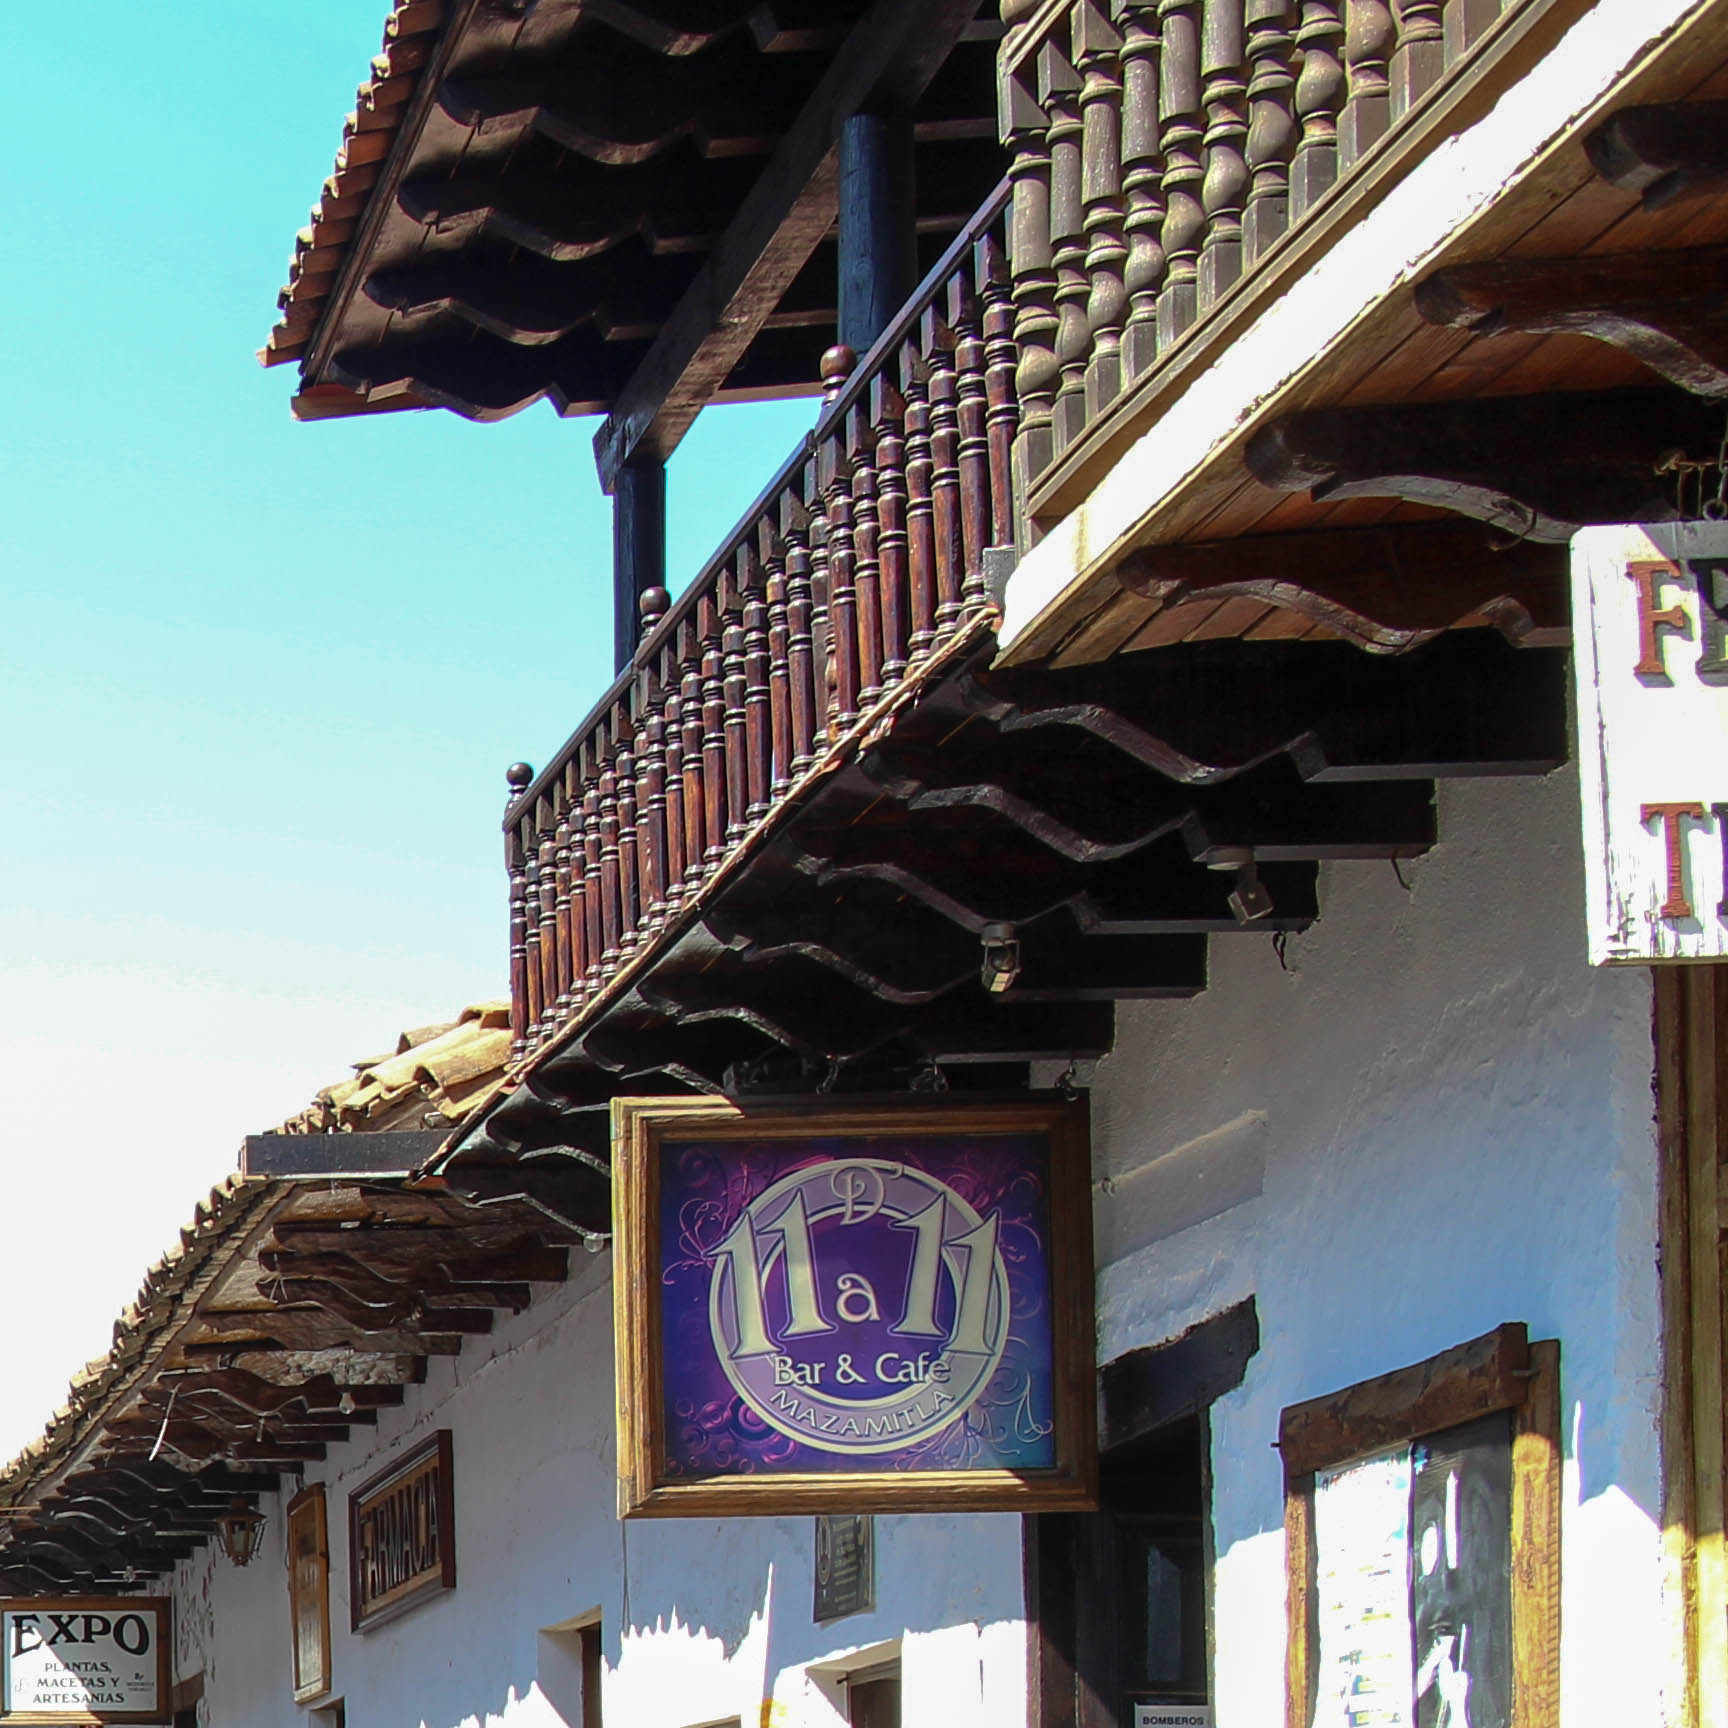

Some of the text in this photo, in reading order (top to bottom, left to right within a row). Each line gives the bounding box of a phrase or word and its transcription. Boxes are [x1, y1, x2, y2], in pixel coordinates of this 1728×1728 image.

[773, 1353, 825, 1386] Bar
[834, 1354, 867, 1386] &
[770, 1389, 957, 1438] MAZAMITLA
[358, 1466, 440, 1606] FARMACIA
[11, 1613, 150, 1659] EXPO
[44, 1661, 113, 1674] PLANTAS,
[36, 1677, 106, 1688] MACETAS
[111, 1676, 121, 1688] Y
[32, 1692, 126, 1704] ARTESANIAS
[1142, 1716, 1205, 1726] BOMBEROS
